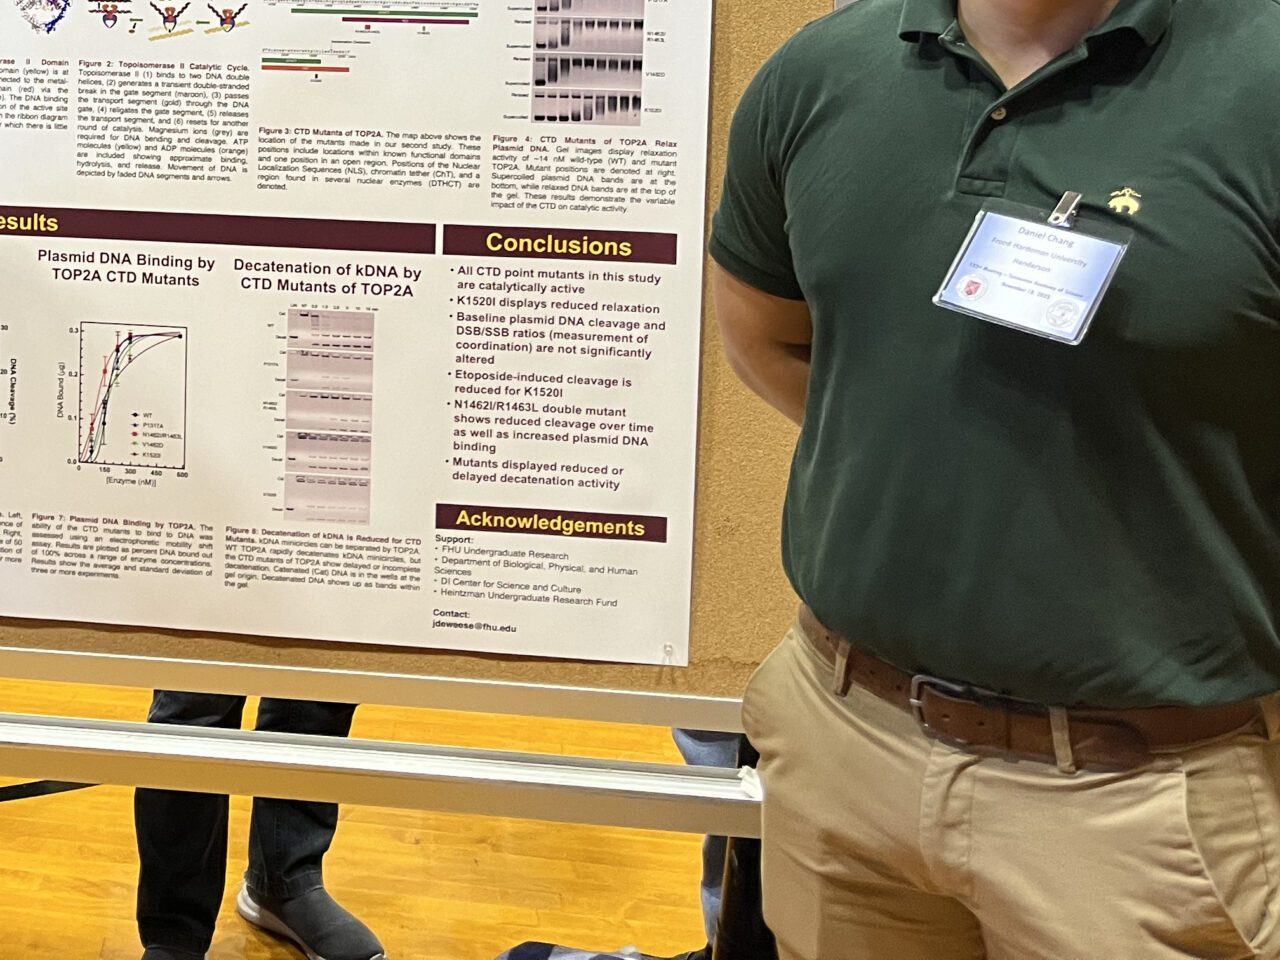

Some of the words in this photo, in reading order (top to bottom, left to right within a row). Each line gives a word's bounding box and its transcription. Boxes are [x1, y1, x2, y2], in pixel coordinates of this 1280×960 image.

[486, 232, 631, 256] Conclusions
[1018, 227, 1046, 239] Daniel
[1048, 233, 1075, 248] Chang
[37, 249, 94, 263] Plasmid
[99, 251, 132, 265] DNA
[136, 253, 192, 271] Binding
[197, 256, 215, 271] by
[234, 258, 331, 274] Decatenation
[336, 263, 351, 275] of
[355, 264, 398, 278] kDNA
[403, 266, 421, 282] by
[51, 267, 101, 281] TOP2A
[106, 270, 136, 283] CTD
[141, 271, 199, 286] Mutants
[457, 265, 473, 275] All
[476, 266, 501, 276] CTD
[504, 268, 534, 279] point
[537, 270, 584, 280] mutants
[588, 271, 599, 280] in
[602, 271, 624, 281] this
[628, 273, 661, 285] study
[240, 276, 272, 290] CTD
[277, 278, 336, 293] Mutants
[341, 282, 357, 294] of
[360, 282, 413, 297] TOP2A
[457, 281, 475, 289] are
[478, 281, 547, 294] catalytically
[550, 284, 585, 294] active
[498, 297, 547, 310] displays
[550, 300, 598, 310] reduced
[601, 302, 660, 313] relaxation
[456, 311, 505, 323] Baseline
[509, 314, 554, 325] plasmid
[558, 315, 584, 326] DNA
[588, 317, 640, 331] cleavage
[643, 321, 665, 330] and
[456, 325, 509, 337] DSB/SSB
[512, 328, 545, 338] ratios
[549, 329, 633, 343] (measurement
[636, 334, 648, 343] of
[455, 510, 644, 535] Acknowledgements
[435, 534, 473, 544] Support:
[441, 544, 461, 553] FHU
[463, 546, 526, 557] Undergraduate
[528, 549, 569, 560] Research
[487, 591, 550, 602] Undergraduate
[552, 595, 593, 605] Research
[595, 597, 617, 607] Fund
